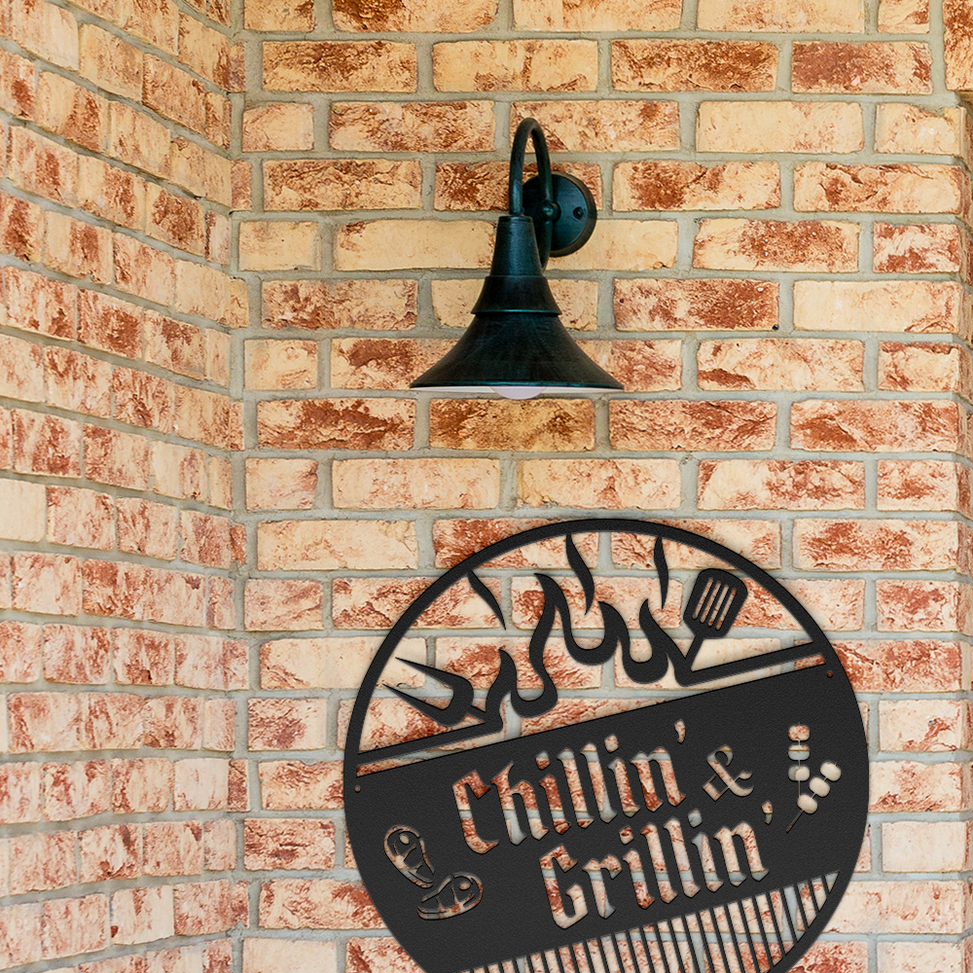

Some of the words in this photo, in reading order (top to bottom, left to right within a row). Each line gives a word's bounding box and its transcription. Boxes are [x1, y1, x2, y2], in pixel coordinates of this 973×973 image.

[452, 719, 686, 854] Chillin'
[702, 744, 754, 801] &
[539, 801, 773, 929] Grillin'
